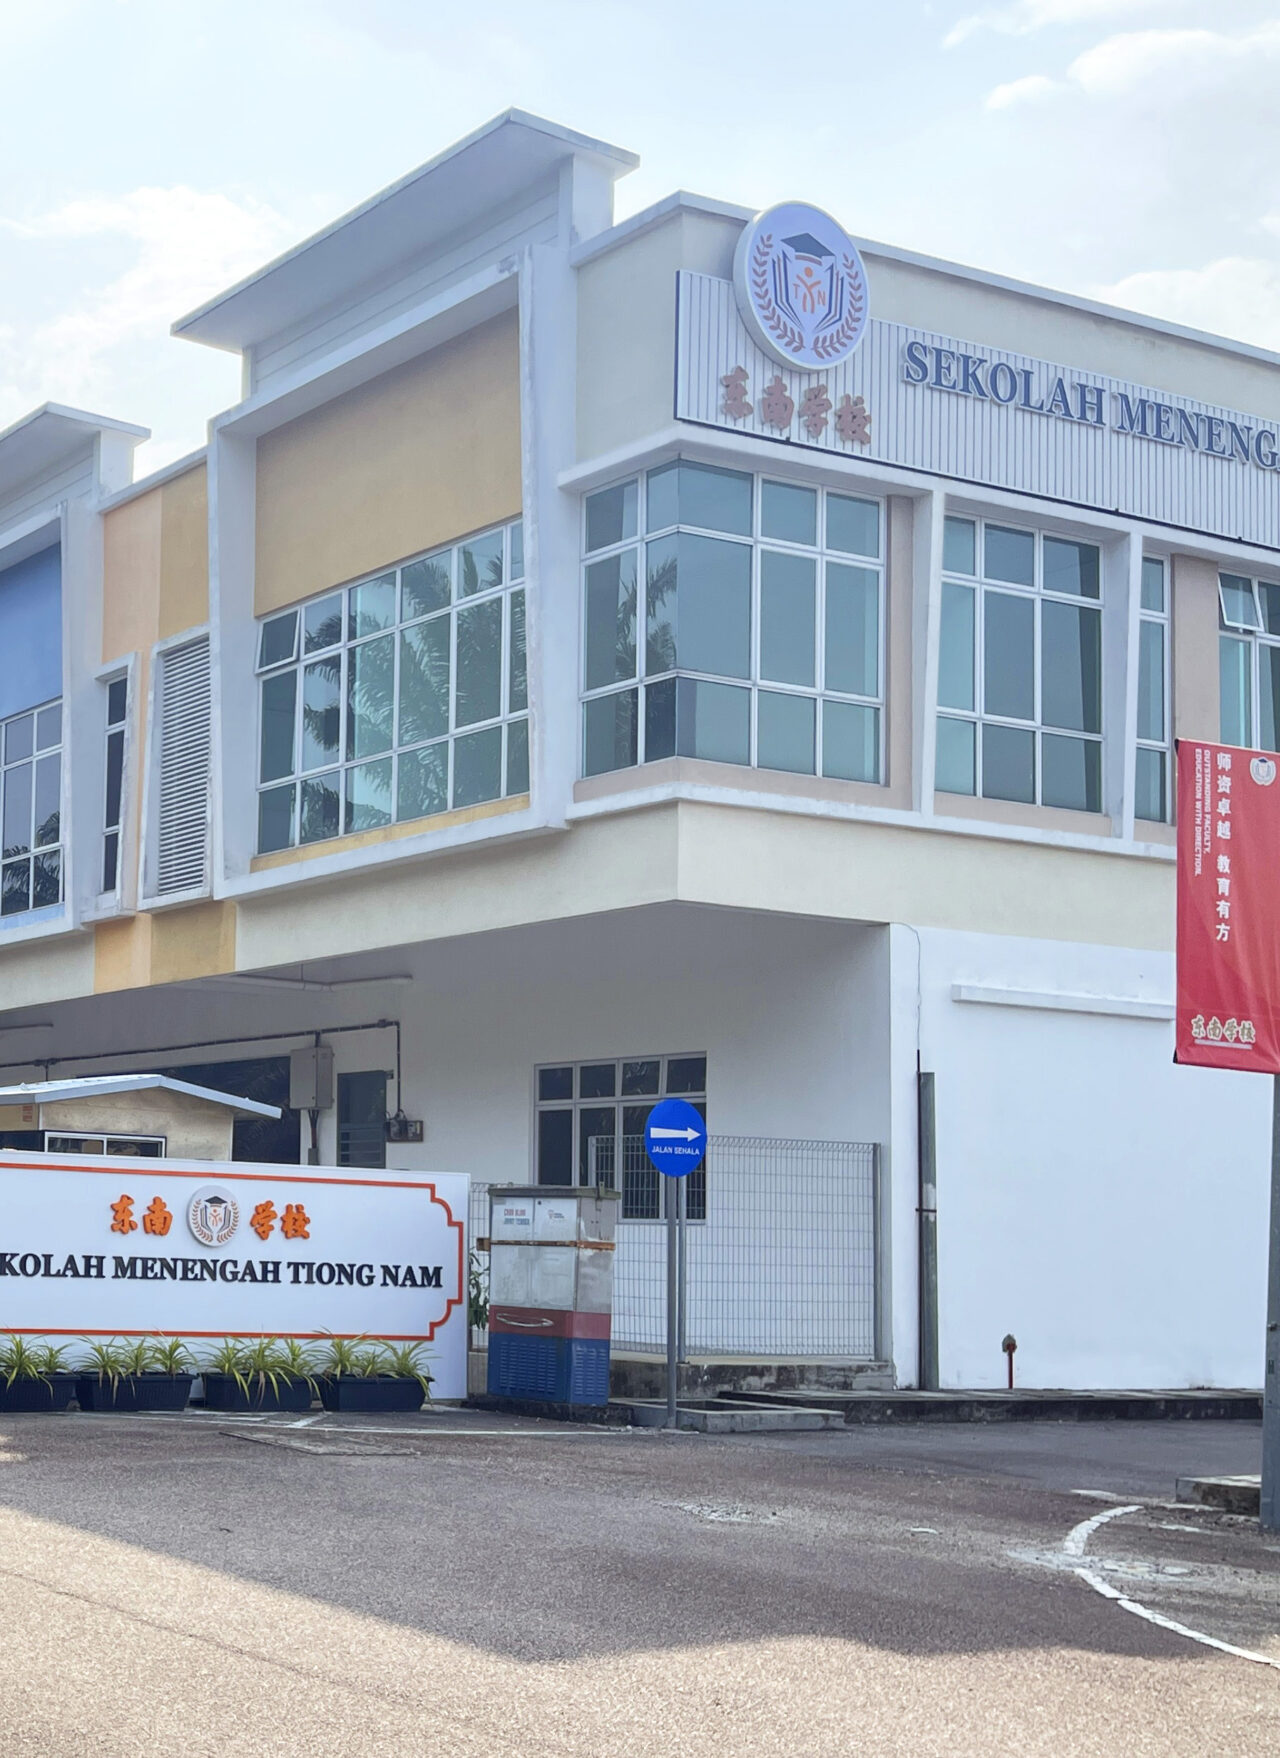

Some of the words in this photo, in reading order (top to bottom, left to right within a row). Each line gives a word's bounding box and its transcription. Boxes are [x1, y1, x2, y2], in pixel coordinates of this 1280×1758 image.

[904, 340, 1107, 427] SEKOLAH
[1116, 391, 1280, 471] MENENG
[1194, 748, 1202, 800] EDUCATION
[1216, 752, 1232, 840] 师资卓越
[1194, 800, 1202, 826] WITH
[1216, 854, 1231, 942] 教育有方
[1191, 1014, 1255, 1043] 东南学校
[652, 1145, 673, 1154] JALAN
[674, 1146, 700, 1155] SEHALA
[110, 1194, 173, 1236] 东南
[250, 1200, 311, 1240] 学校
[111, 1256, 281, 1285] MENENGAH
[287, 1262, 376, 1287] TIONG
[380, 1264, 443, 1288] NAM
